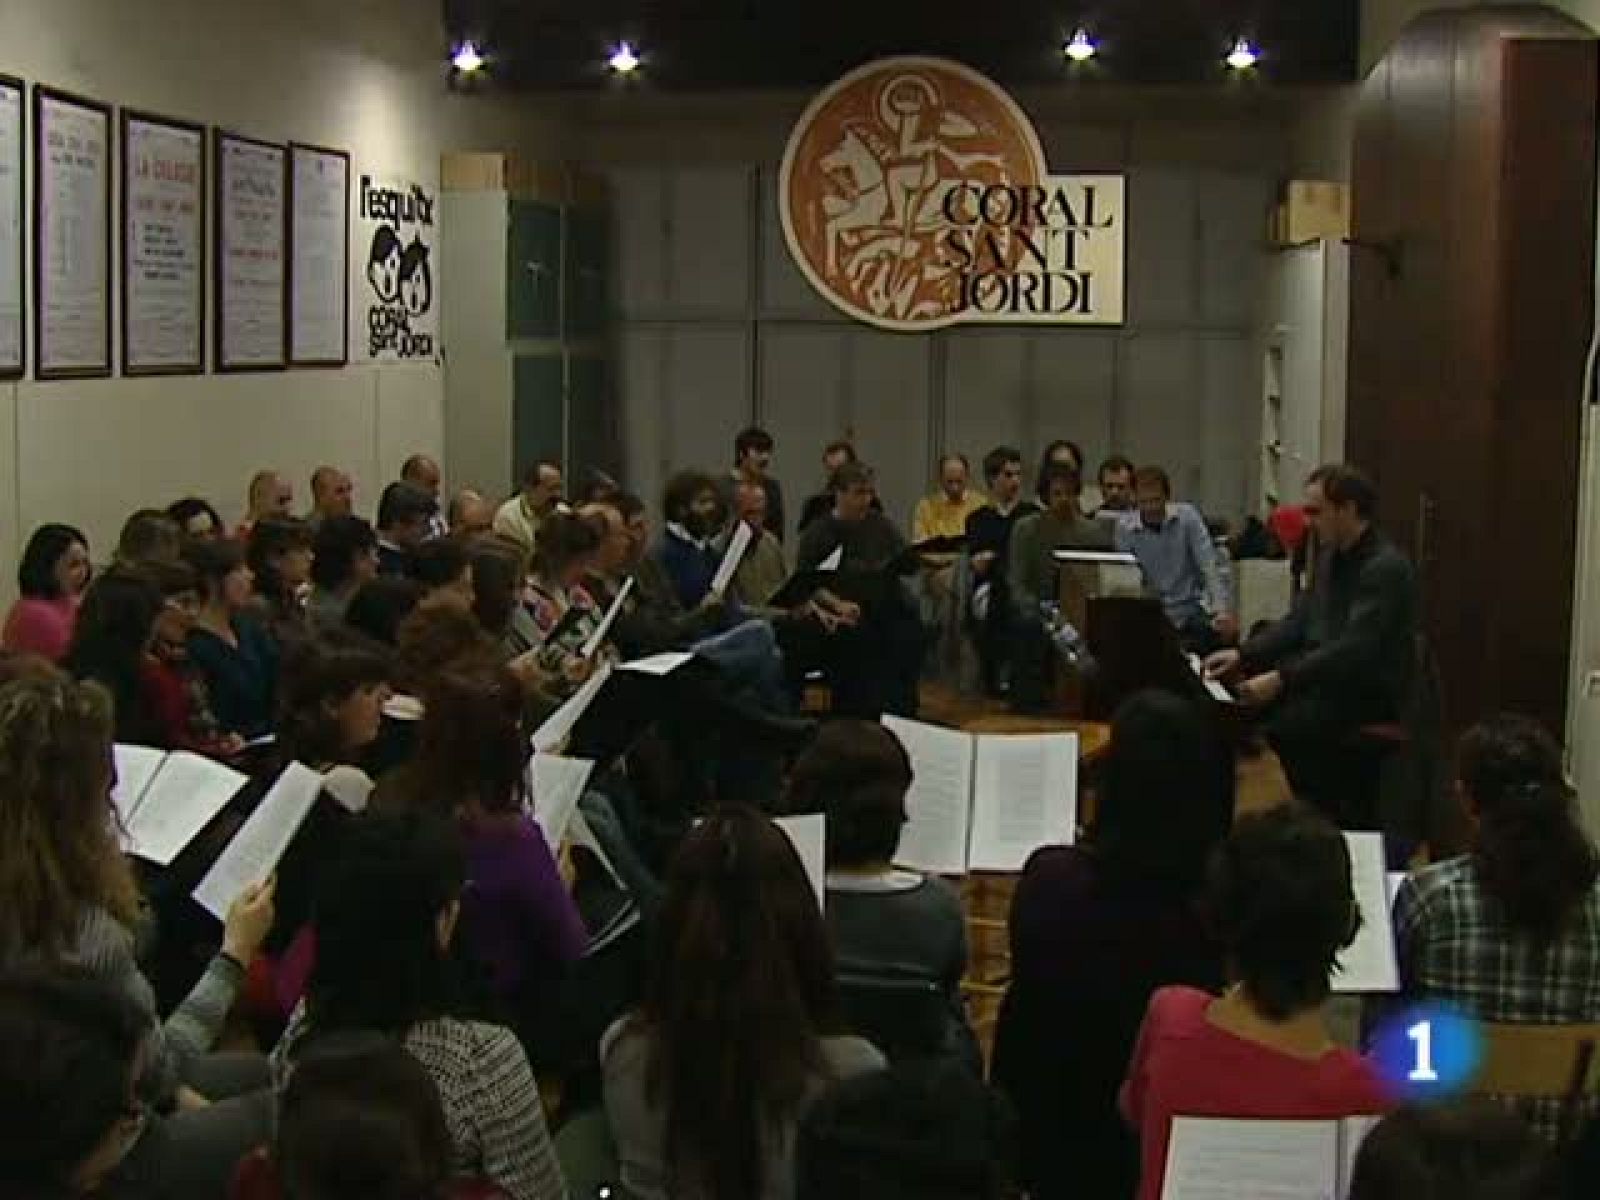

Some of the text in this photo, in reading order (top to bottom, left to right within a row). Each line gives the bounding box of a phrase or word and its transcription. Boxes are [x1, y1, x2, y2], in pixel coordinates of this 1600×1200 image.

[943, 185, 1113, 227] CORAL
[943, 229, 1091, 271] SANT
[950, 272, 1093, 313] JORDI
